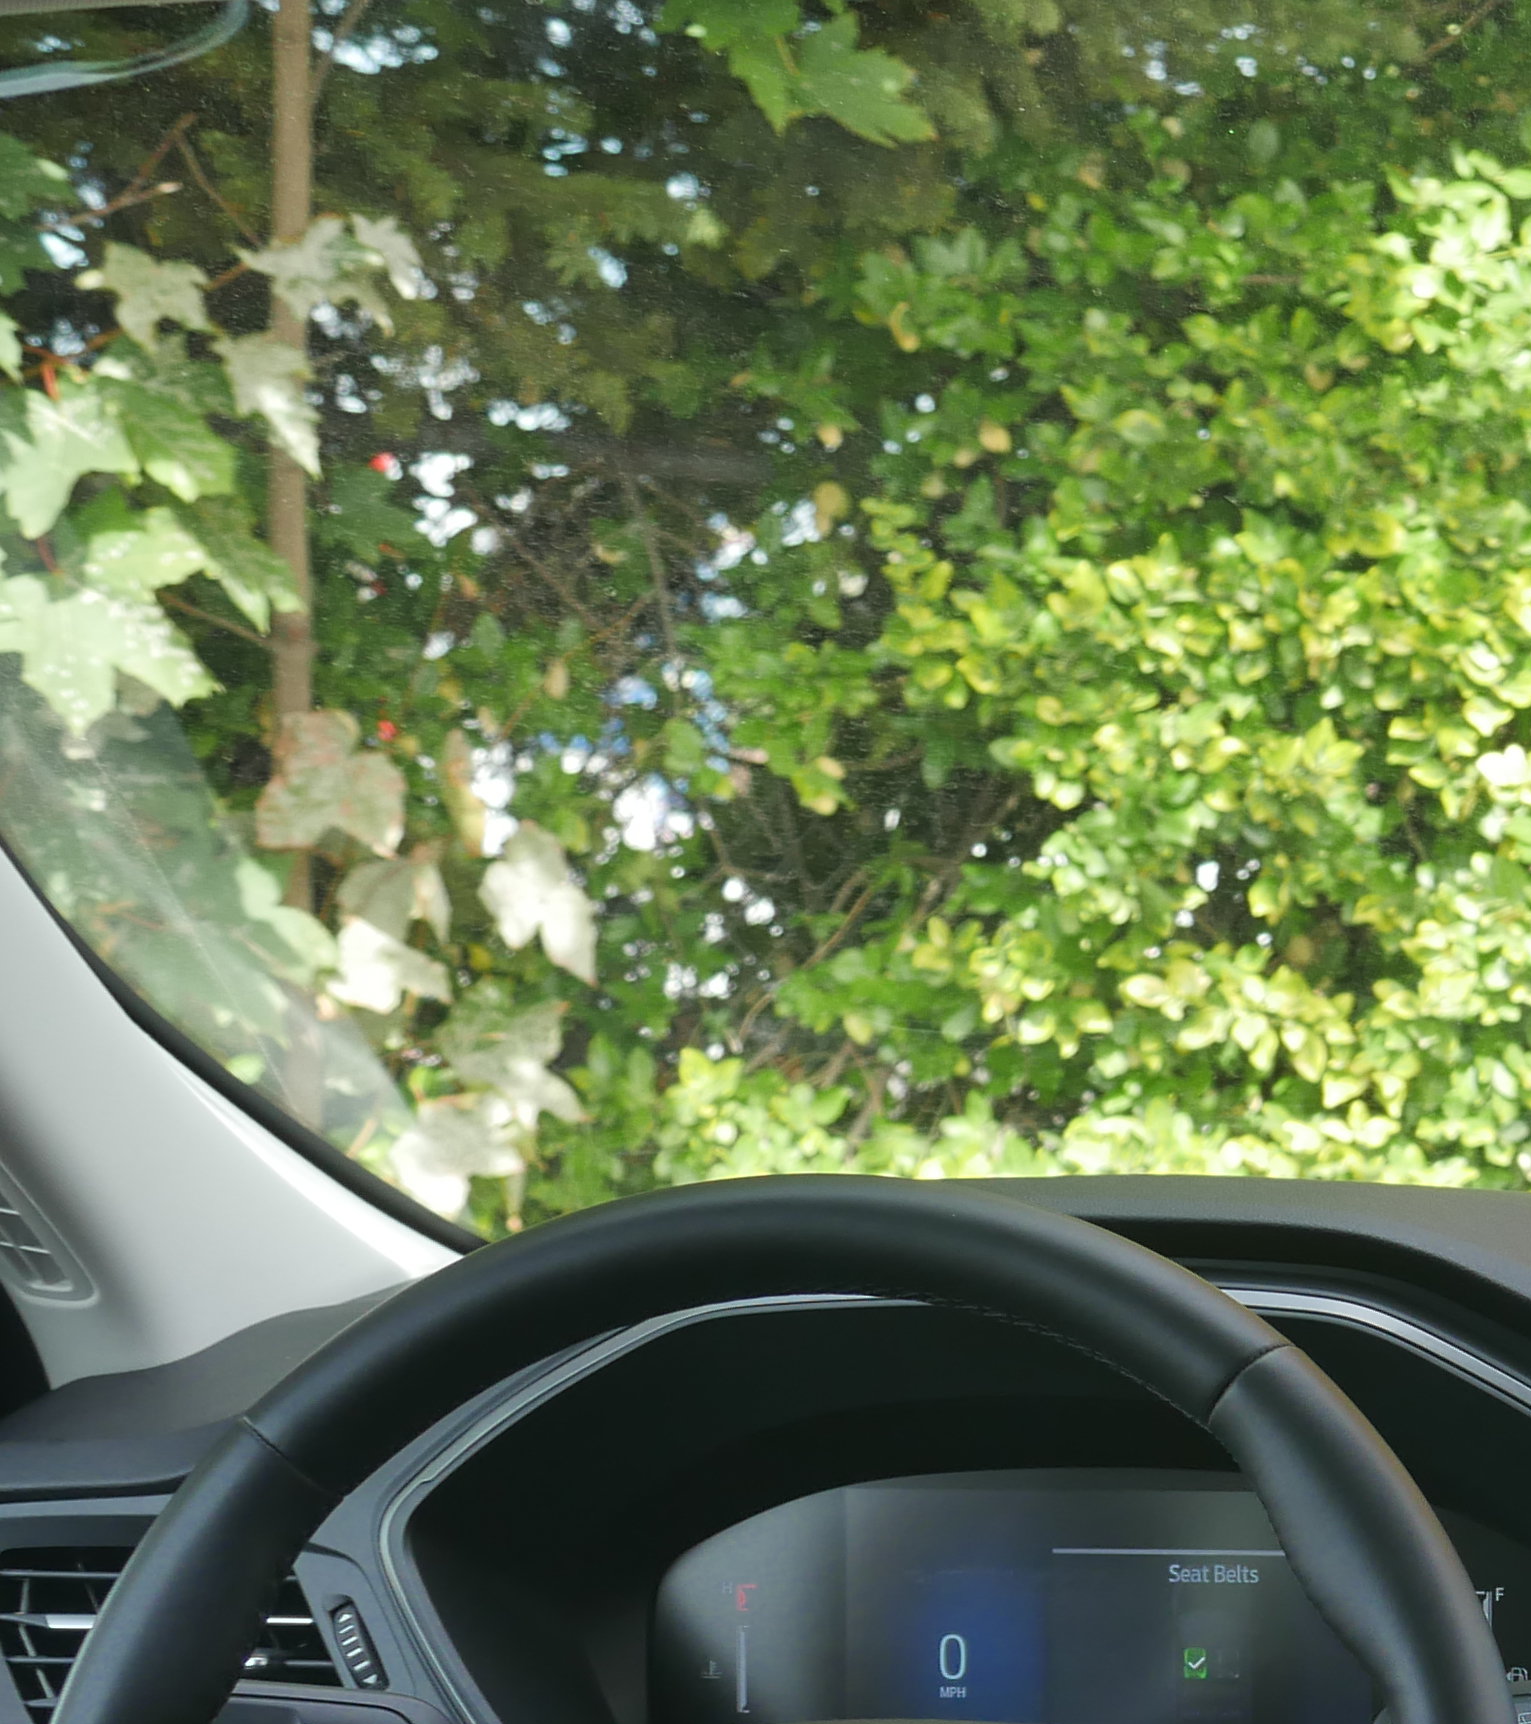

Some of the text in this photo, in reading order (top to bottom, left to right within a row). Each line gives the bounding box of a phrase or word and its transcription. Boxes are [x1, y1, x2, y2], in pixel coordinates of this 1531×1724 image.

[1168, 1564, 1259, 1583] Seat Belts
[1495, 1587, 1505, 1601] F
[939, 1633, 967, 1680] 0
[939, 1686, 966, 1698] MPH
